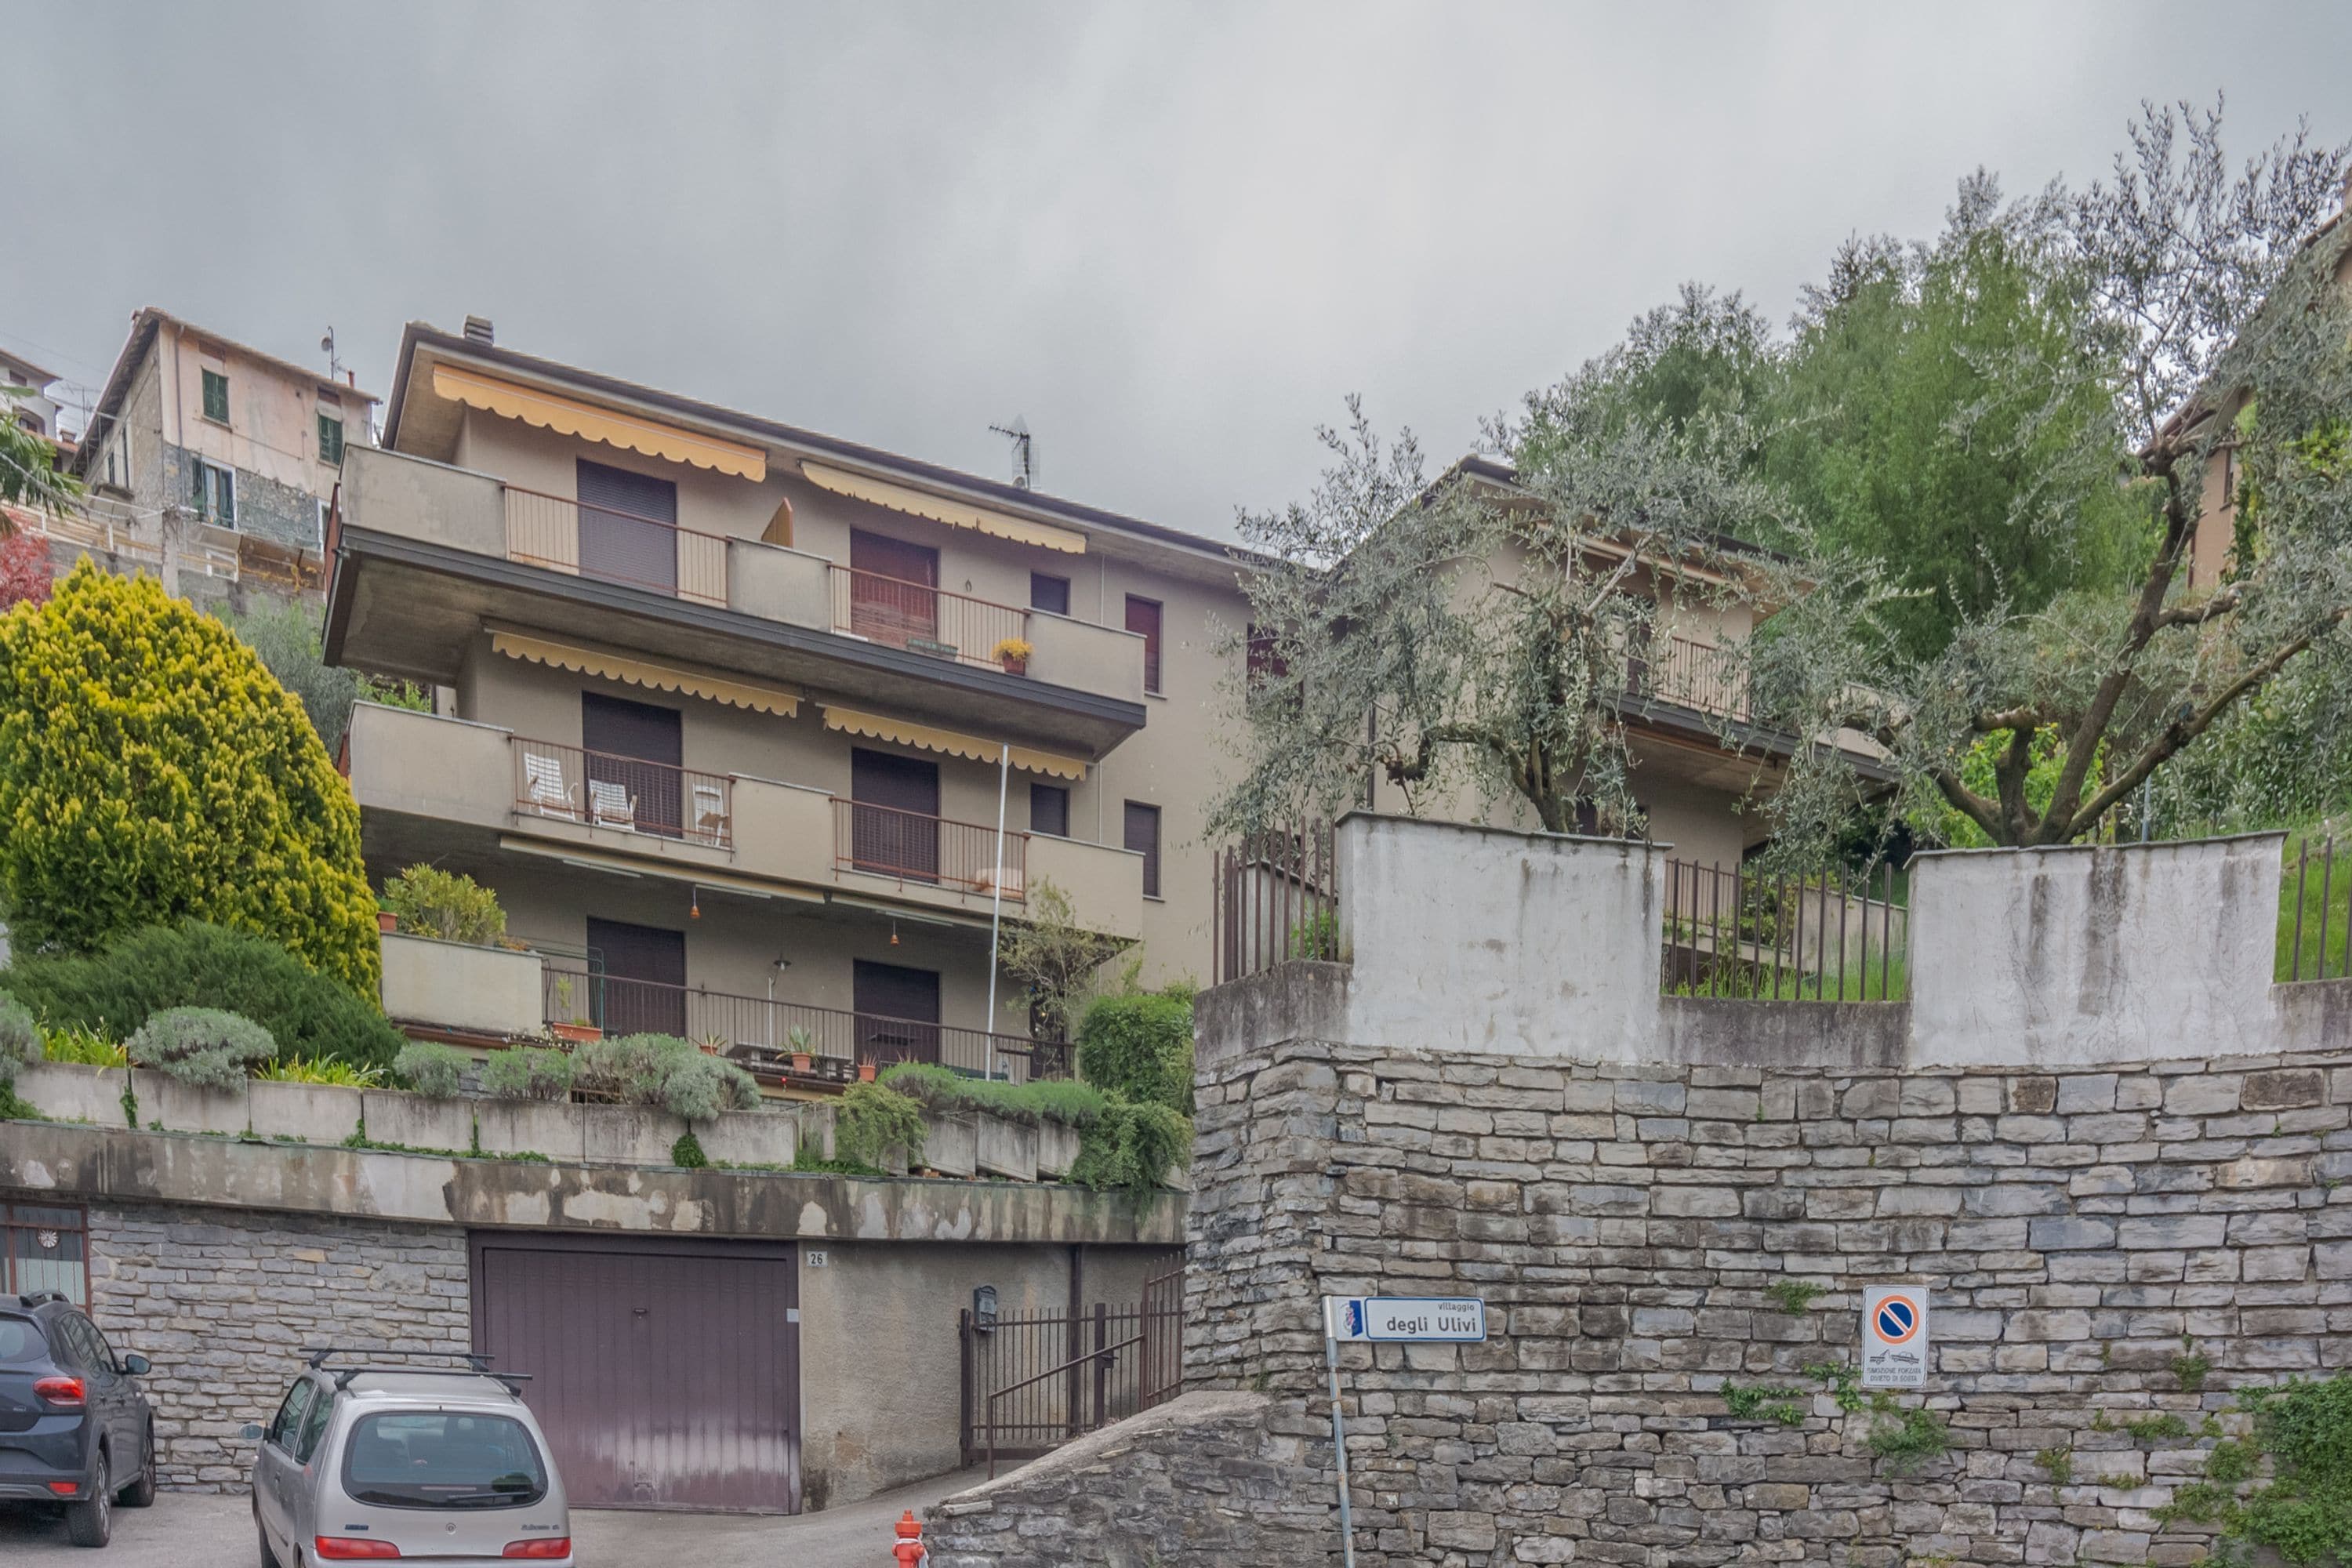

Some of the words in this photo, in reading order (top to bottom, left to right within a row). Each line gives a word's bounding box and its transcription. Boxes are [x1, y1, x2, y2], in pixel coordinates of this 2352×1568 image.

[811, 1254, 823, 1265] 26
[1438, 1302, 1475, 1312] villaggio
[1387, 1316, 1428, 1334] degli
[1438, 1317, 1476, 1332] Ulivi
